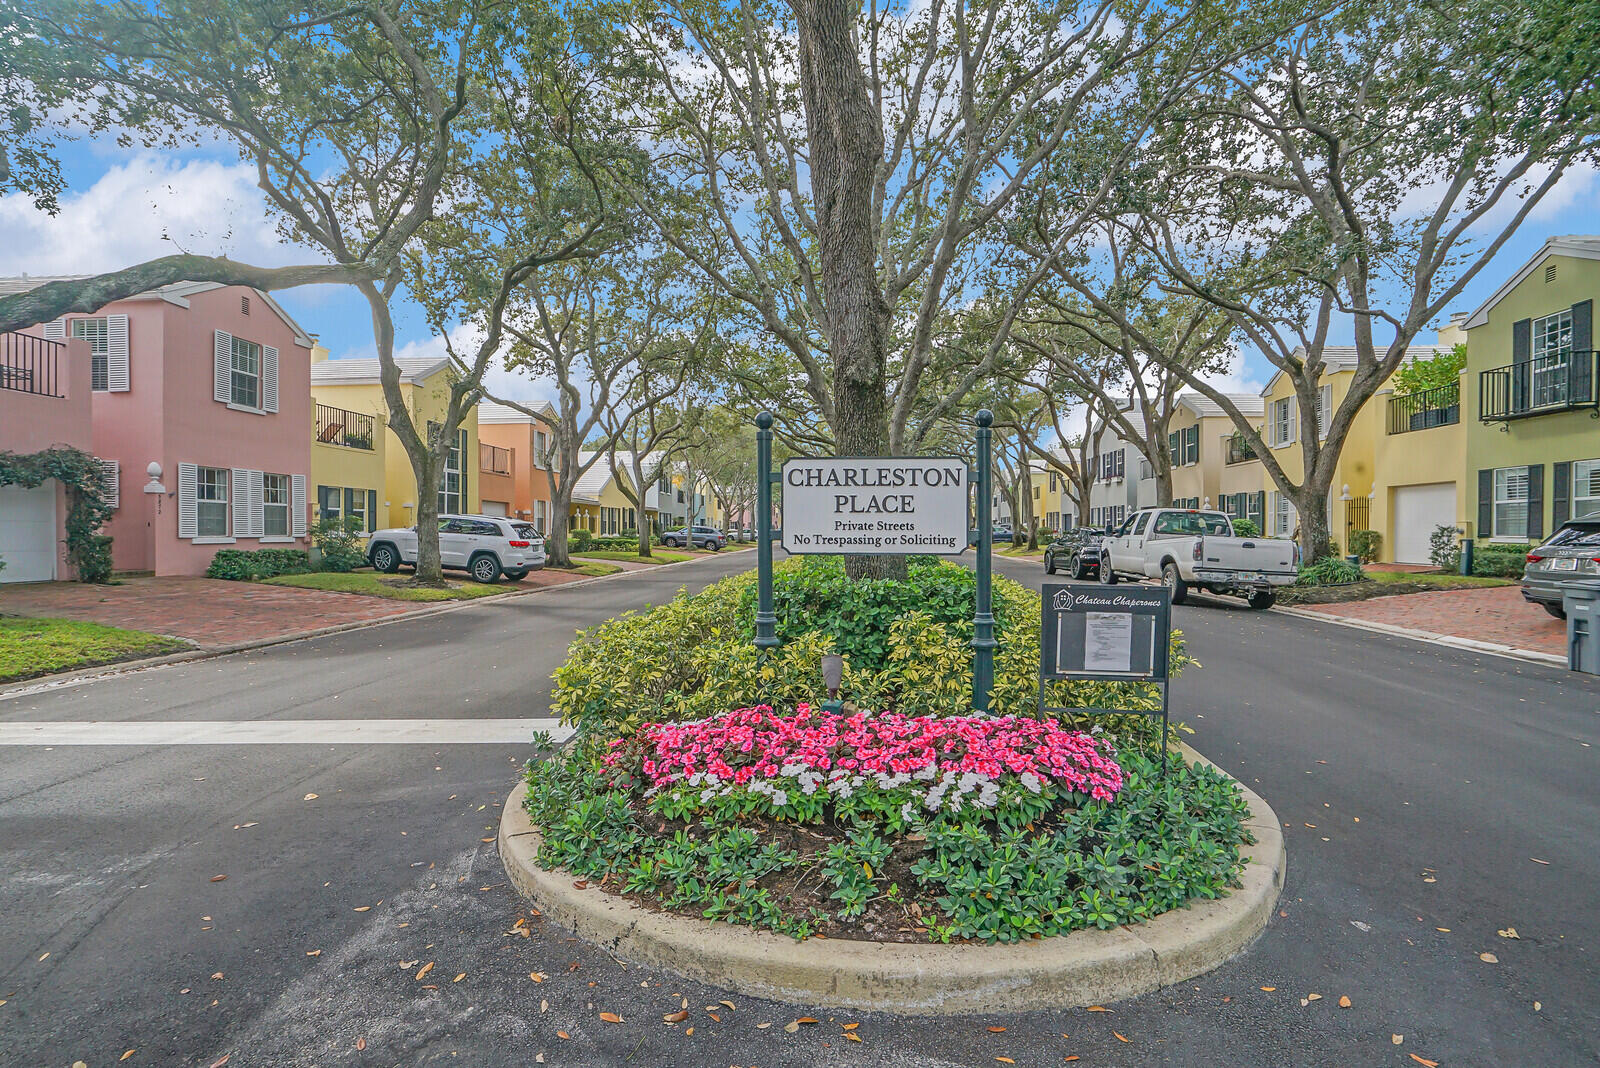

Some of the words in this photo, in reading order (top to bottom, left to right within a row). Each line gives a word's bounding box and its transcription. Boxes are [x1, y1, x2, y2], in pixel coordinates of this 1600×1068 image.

[787, 468, 962, 487] CHARLESTON
[834, 494, 915, 513] PLACE
[834, 521, 874, 531] Private
[877, 521, 915, 531] Streets
[794, 535, 810, 545] No
[813, 534, 882, 547] Trespassing
[885, 537, 897, 545] or
[900, 534, 957, 547] Soliciting
[1075, 594, 1111, 605] Chateau
[1113, 596, 1161, 608] Chaperones
